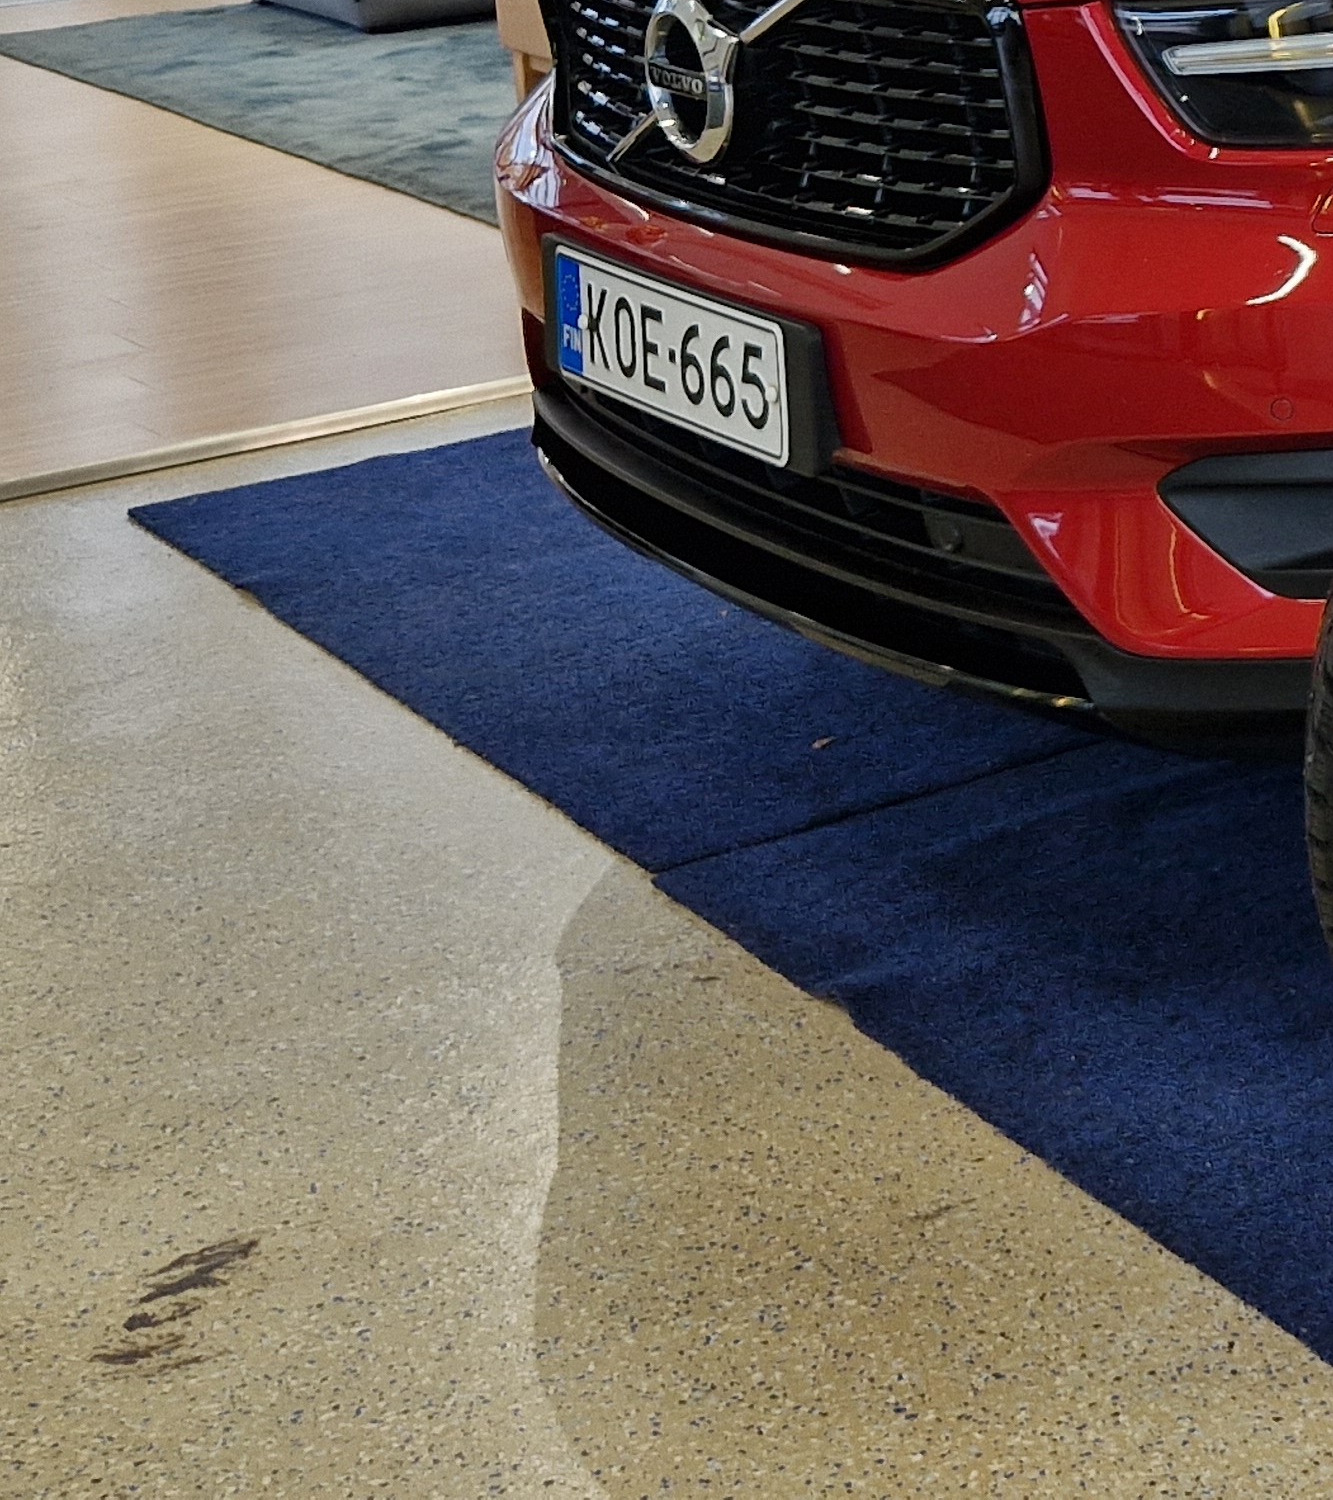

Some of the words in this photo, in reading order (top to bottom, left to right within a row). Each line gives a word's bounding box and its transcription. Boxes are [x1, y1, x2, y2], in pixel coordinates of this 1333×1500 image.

[650, 66, 703, 93] VOLVO
[562, 323, 584, 355] FIN
[587, 282, 770, 430] KOE-665
